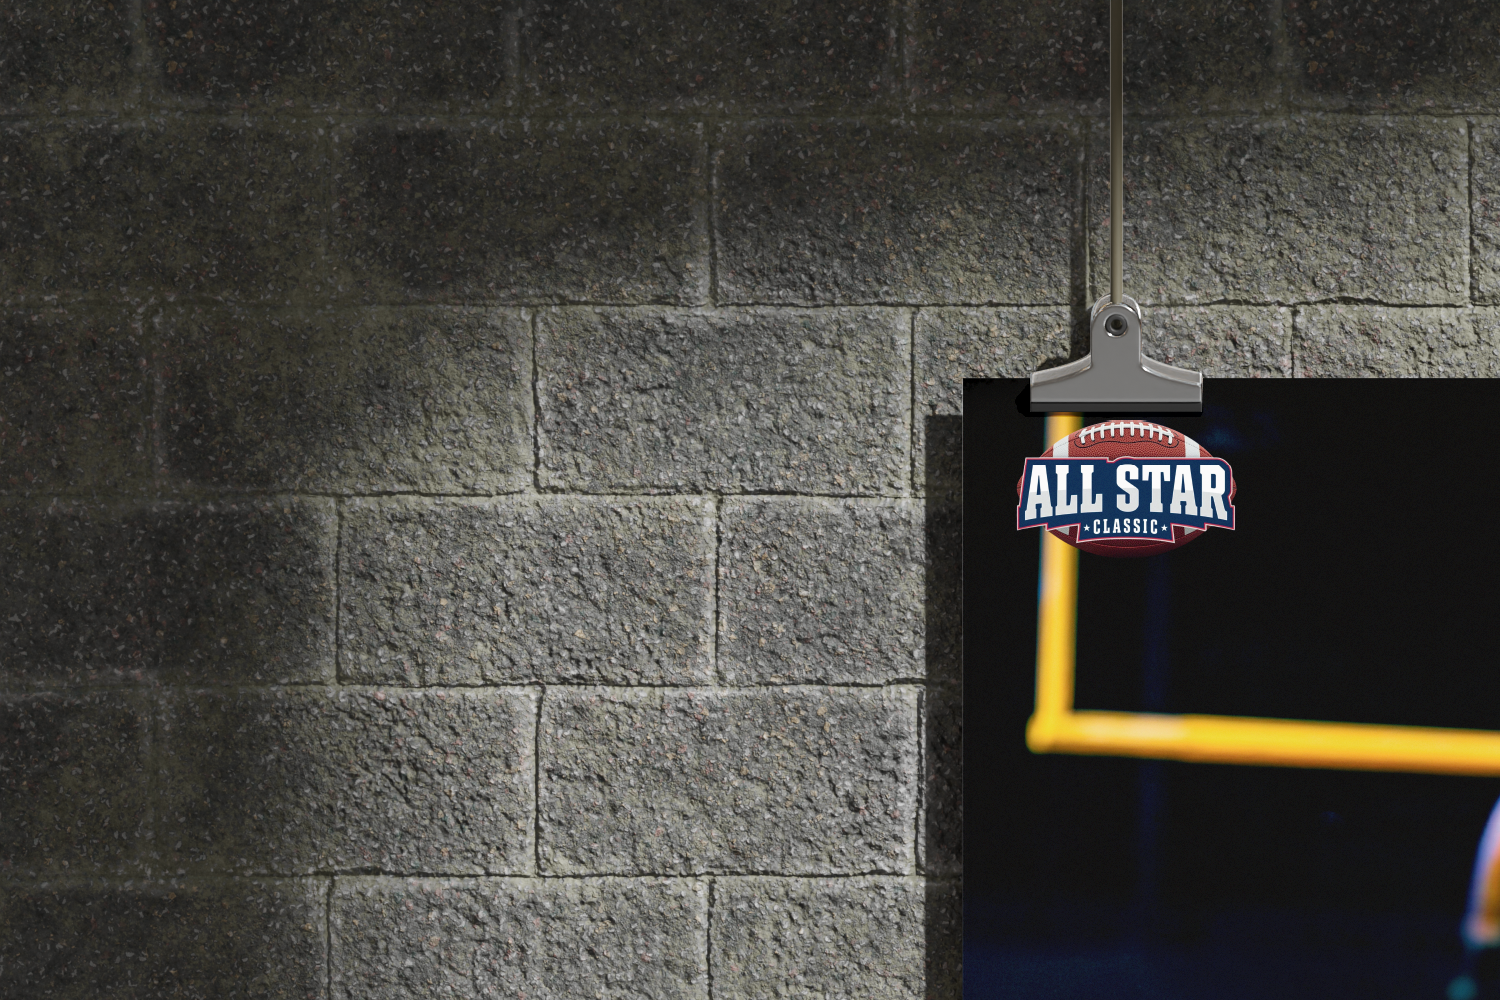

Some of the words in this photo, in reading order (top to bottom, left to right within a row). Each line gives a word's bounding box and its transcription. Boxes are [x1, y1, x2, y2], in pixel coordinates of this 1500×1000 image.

[1024, 464, 1103, 521] ALL
[1115, 463, 1228, 521] STAR
[1092, 518, 1159, 535] CLASSIC
